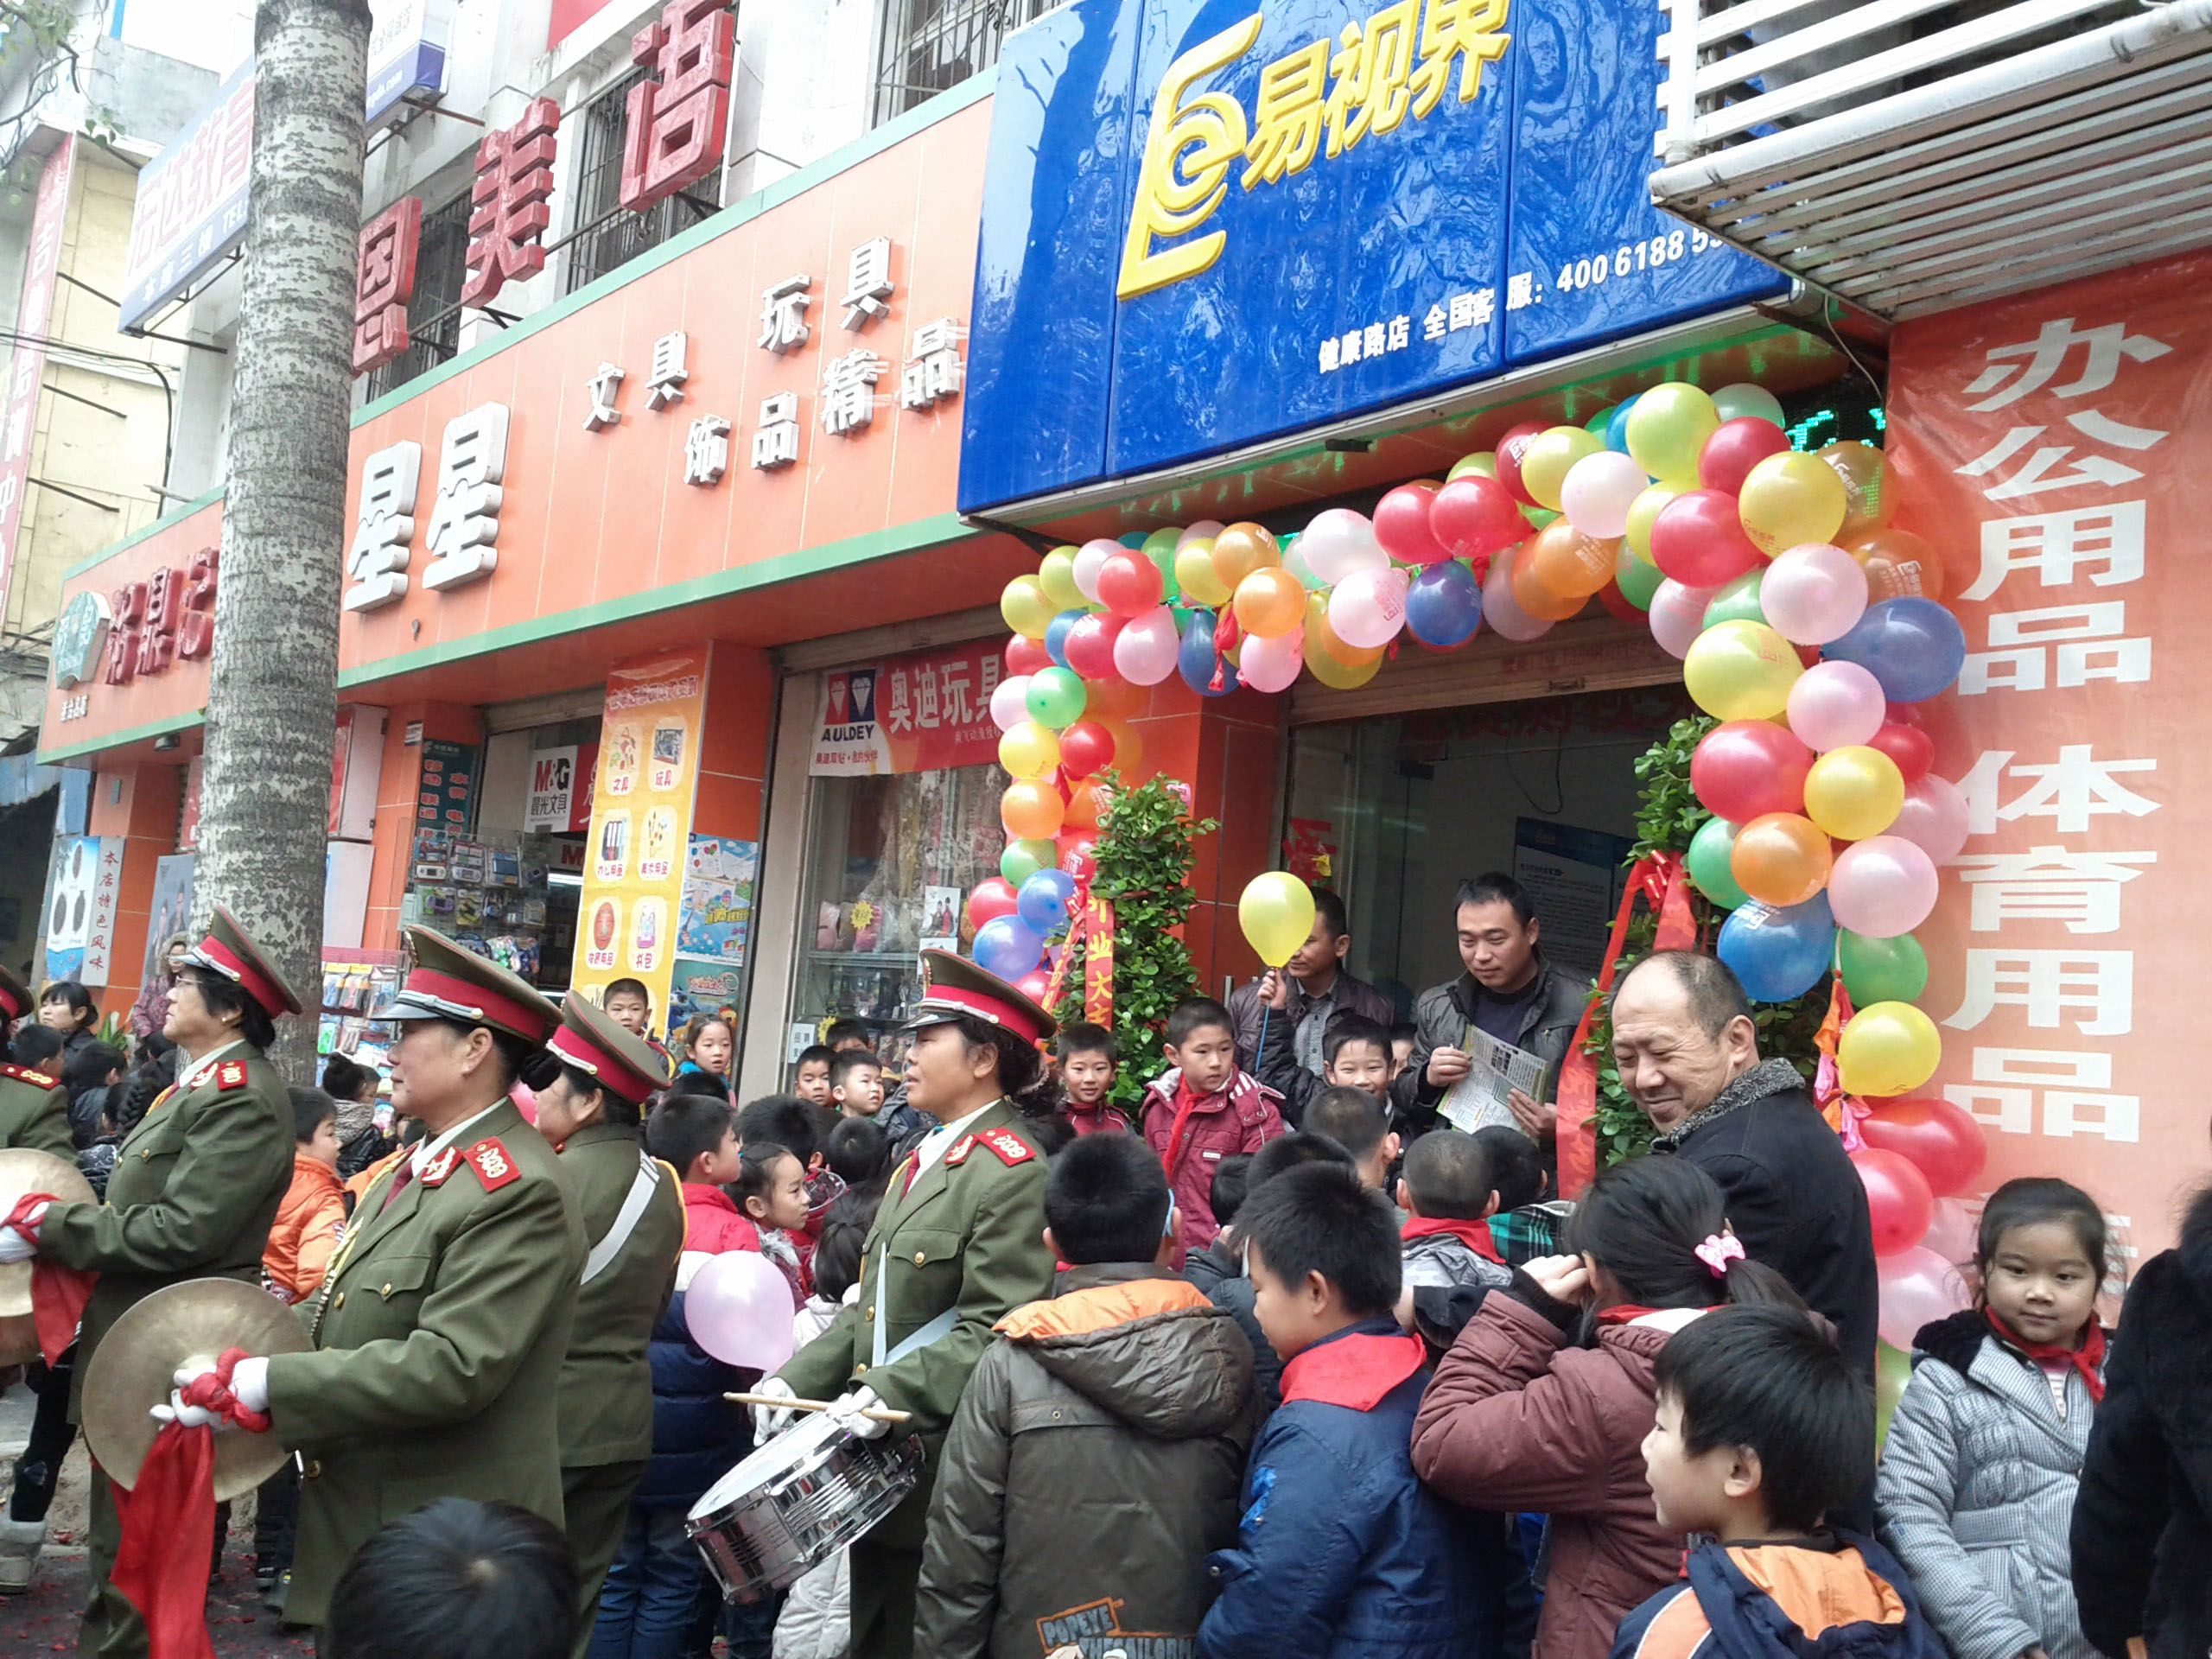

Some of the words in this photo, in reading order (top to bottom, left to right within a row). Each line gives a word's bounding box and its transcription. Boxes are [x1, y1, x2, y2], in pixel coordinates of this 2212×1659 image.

[1241, 0, 1511, 193] 易视界
[582, 331, 689, 432] 文具
[758, 236, 895, 354] 玩具
[1319, 315, 1409, 373] 健康路店
[1556, 255, 1608, 292] 400
[1614, 231, 1684, 276] 6188
[683, 315, 961, 486] 饰品精品
[343, 400, 512, 613] 星星
[1953, 317, 2174, 696] 办公用品
[821, 724, 876, 742] AULDEY
[887, 654, 1000, 734] 奥迪玩具
[531, 793, 568, 816] 晨光文具
[655, 769, 672, 786] 玩具
[89, 851, 119, 970] 本店特色风味
[1941, 743, 2162, 1143] 体育用品
[1042, 1605, 1114, 1649] POPEYE
